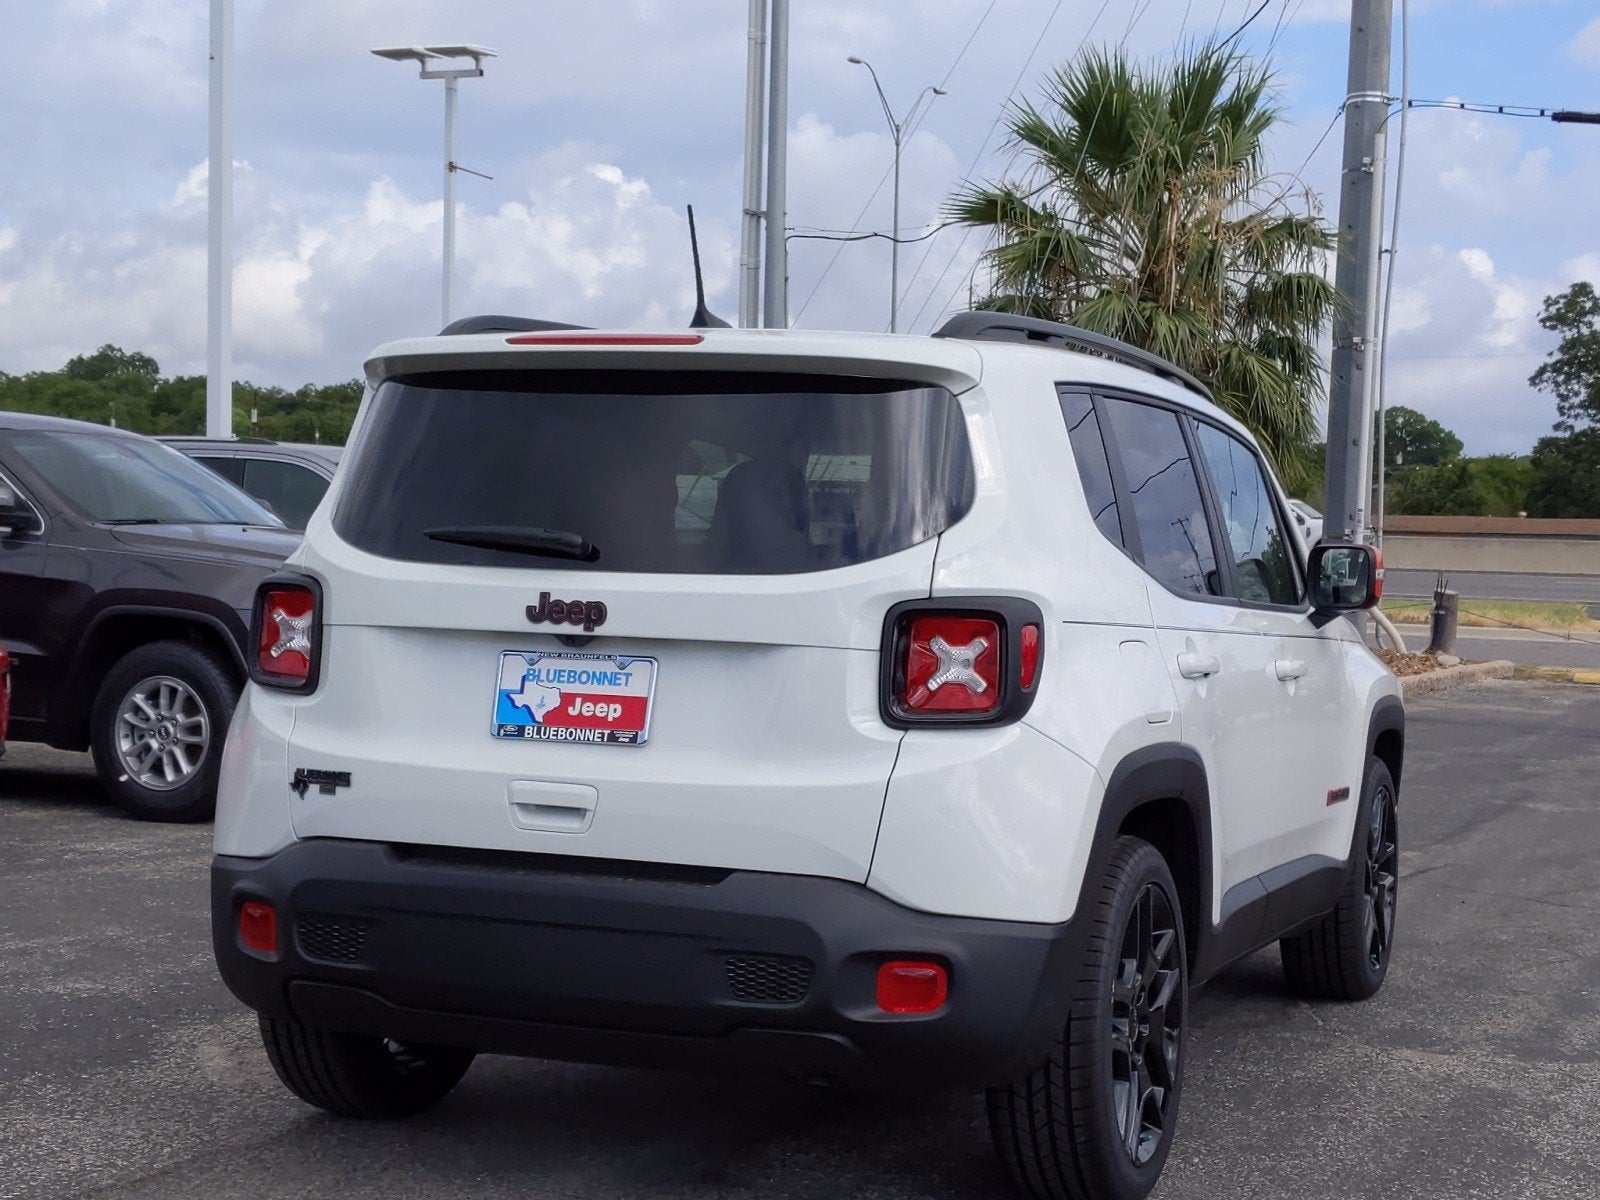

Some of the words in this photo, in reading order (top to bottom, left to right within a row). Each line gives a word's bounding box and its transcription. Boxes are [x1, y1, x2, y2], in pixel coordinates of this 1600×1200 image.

[526, 591, 607, 632] Jeep
[526, 667, 633, 687] BLUEBONNET
[568, 697, 622, 721] Jeep
[524, 725, 611, 742] BLUEBONNET
